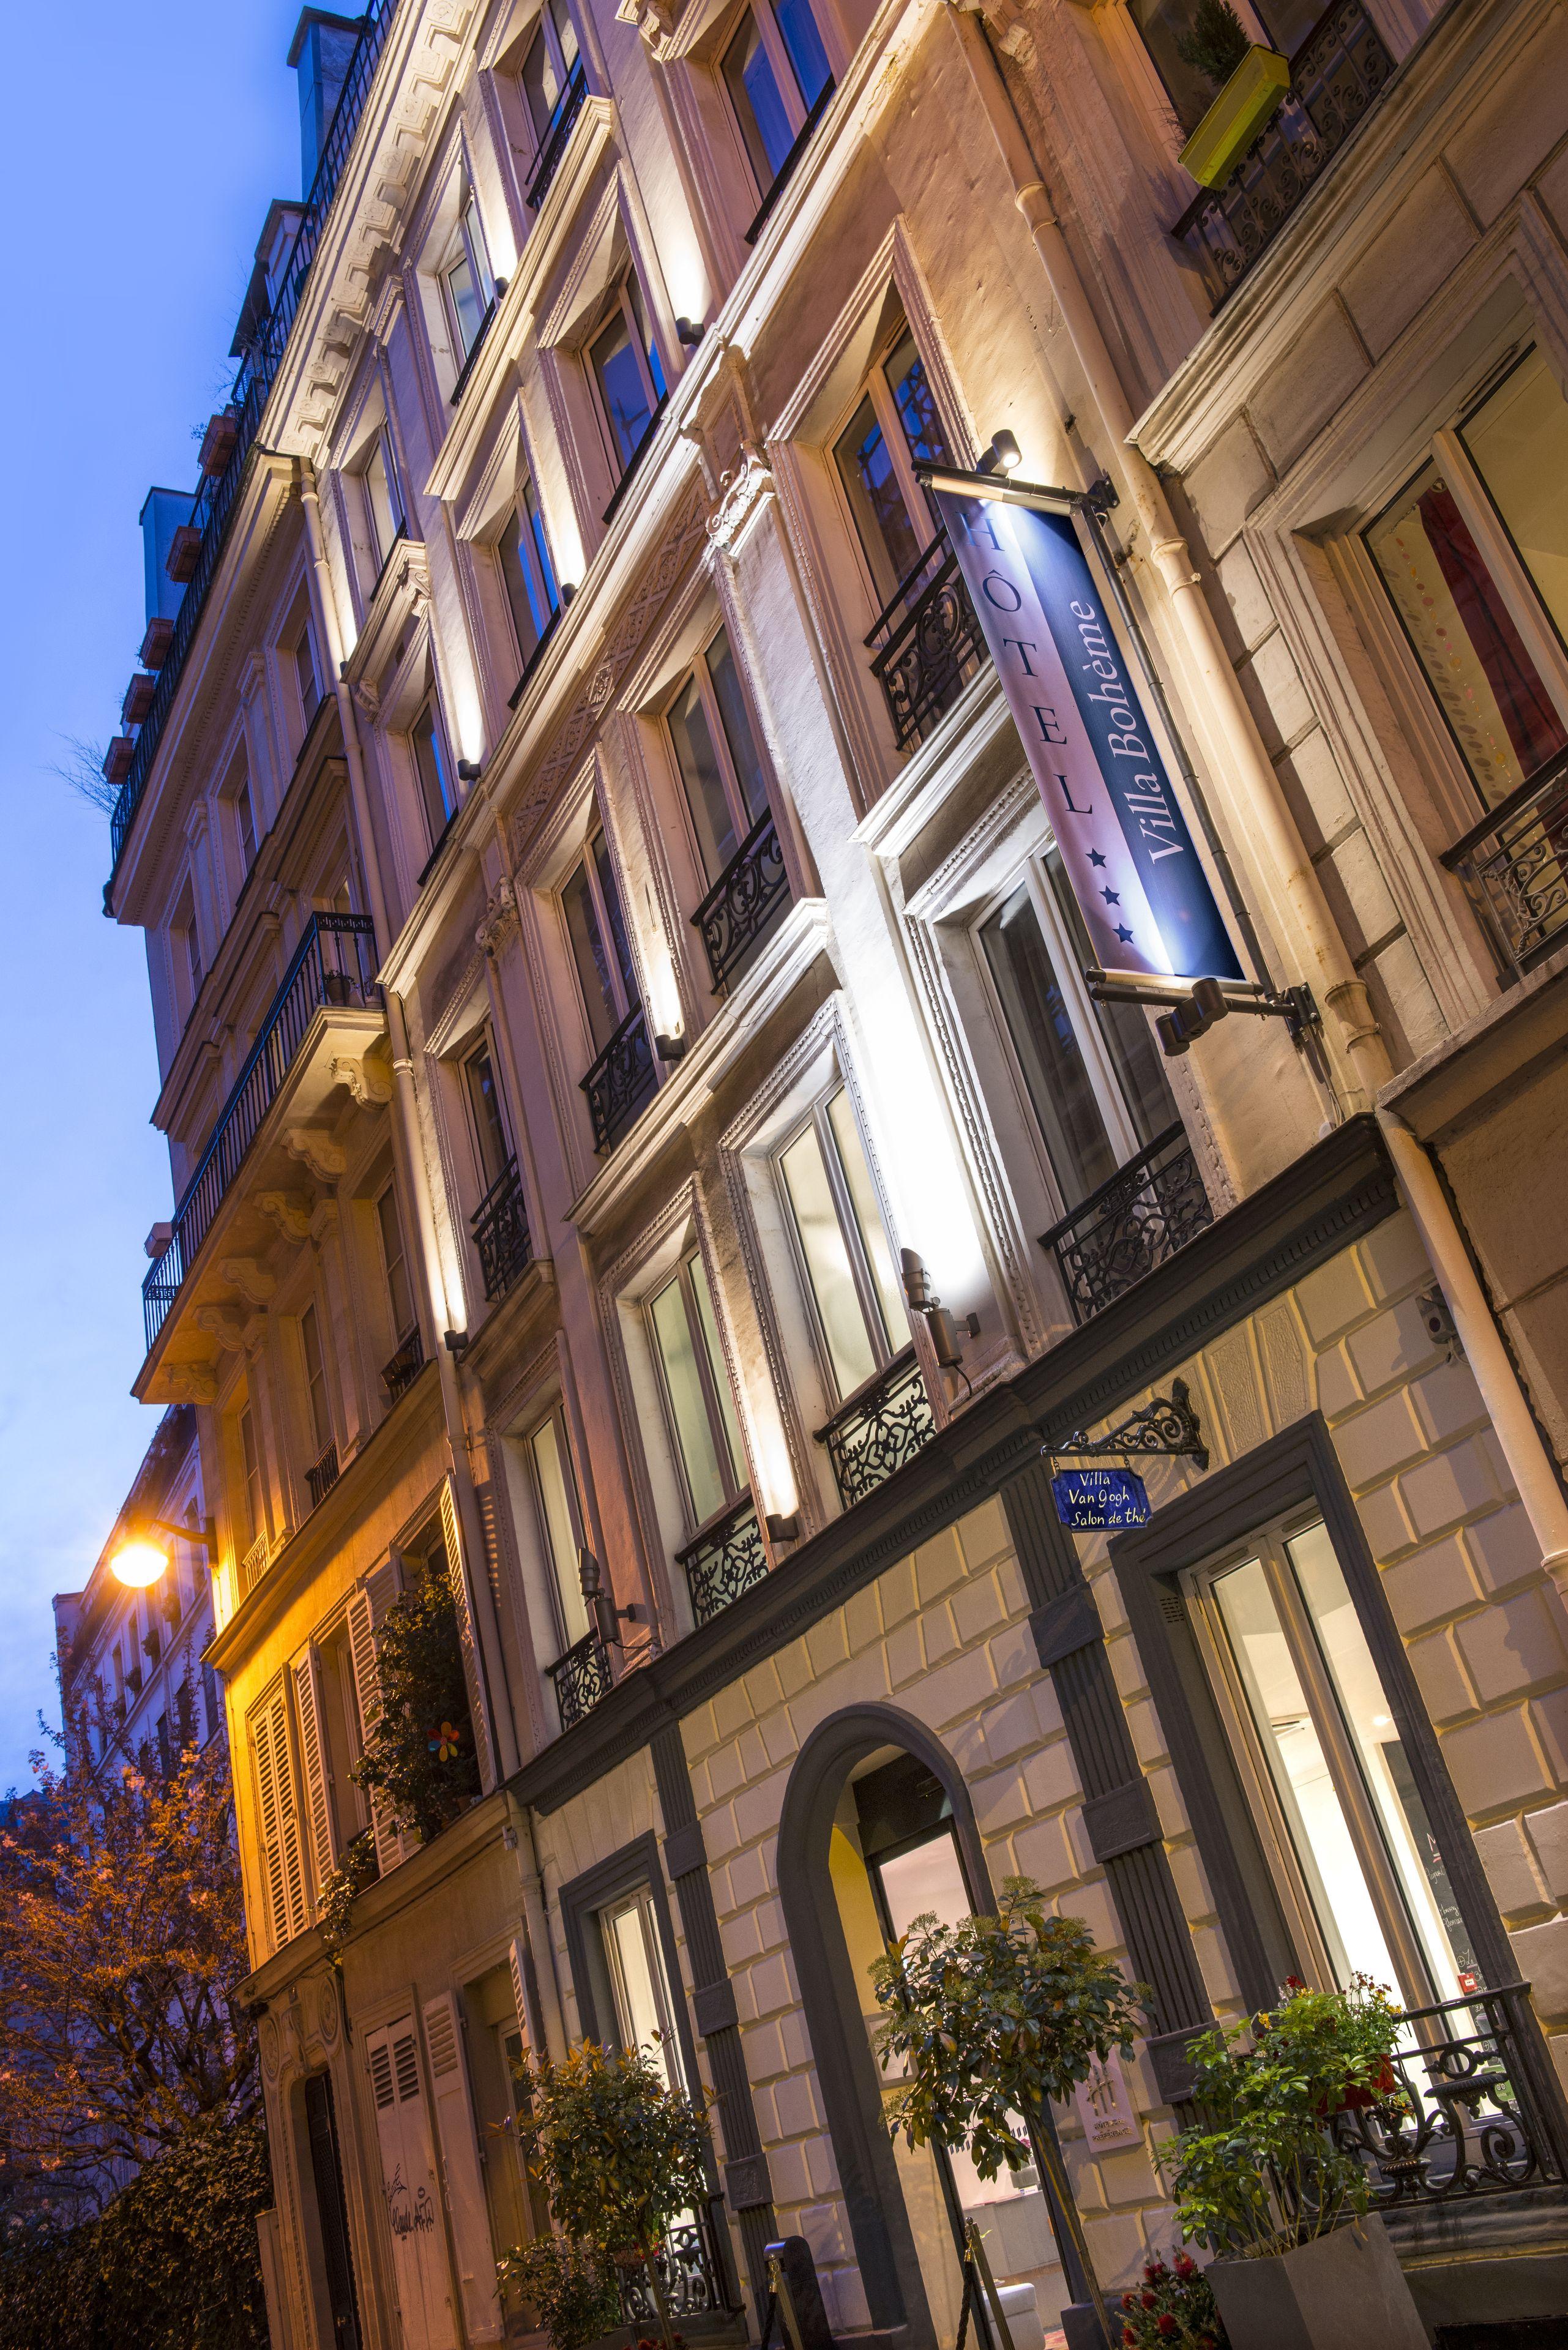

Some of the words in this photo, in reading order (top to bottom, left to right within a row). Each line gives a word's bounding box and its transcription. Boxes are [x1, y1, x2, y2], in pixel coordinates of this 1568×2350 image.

[956, 511, 1093, 815] HÔTEL
[1070, 600, 1151, 764] Bohème
[1124, 773, 1184, 865] Villa
[1069, 1488, 1094, 1504] Van
[1080, 1471, 1110, 1486] Villa
[1071, 1510, 1105, 1526] Salon
[1108, 1511, 1122, 1524] de
[1124, 1507, 1146, 1523] thé
